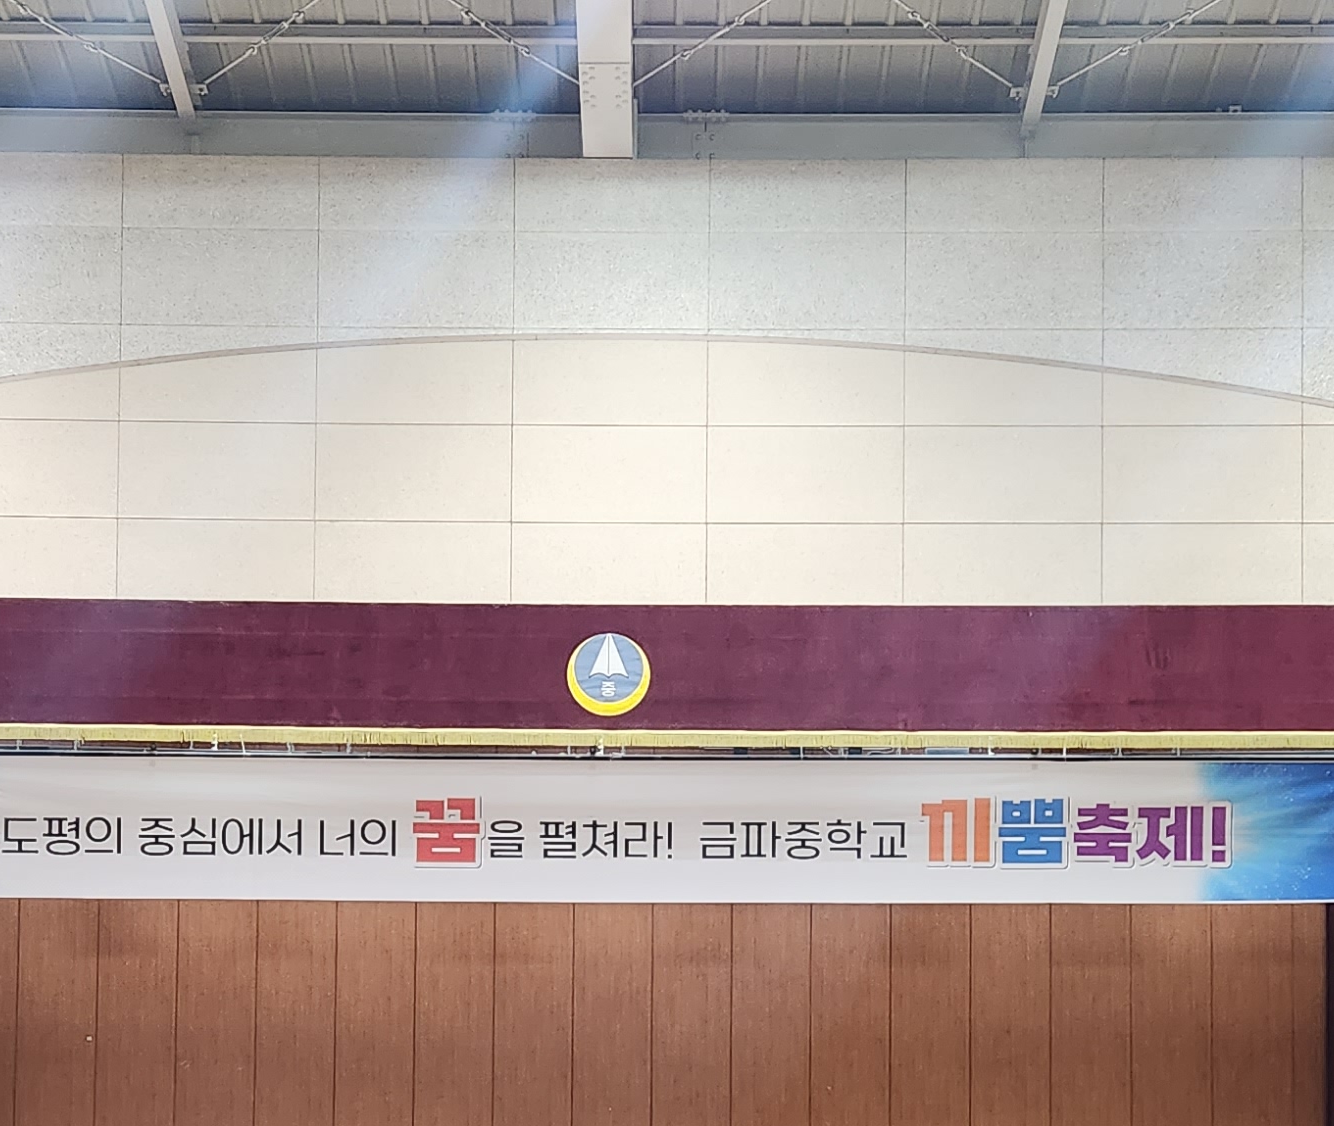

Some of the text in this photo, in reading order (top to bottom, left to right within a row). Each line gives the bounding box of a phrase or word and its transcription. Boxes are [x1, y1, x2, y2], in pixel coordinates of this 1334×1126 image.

[138, 816, 304, 856] 중심에서
[318, 818, 397, 857] 너의
[539, 819, 674, 859] 펼쳐라!
[699, 818, 908, 860] 금파중학교
